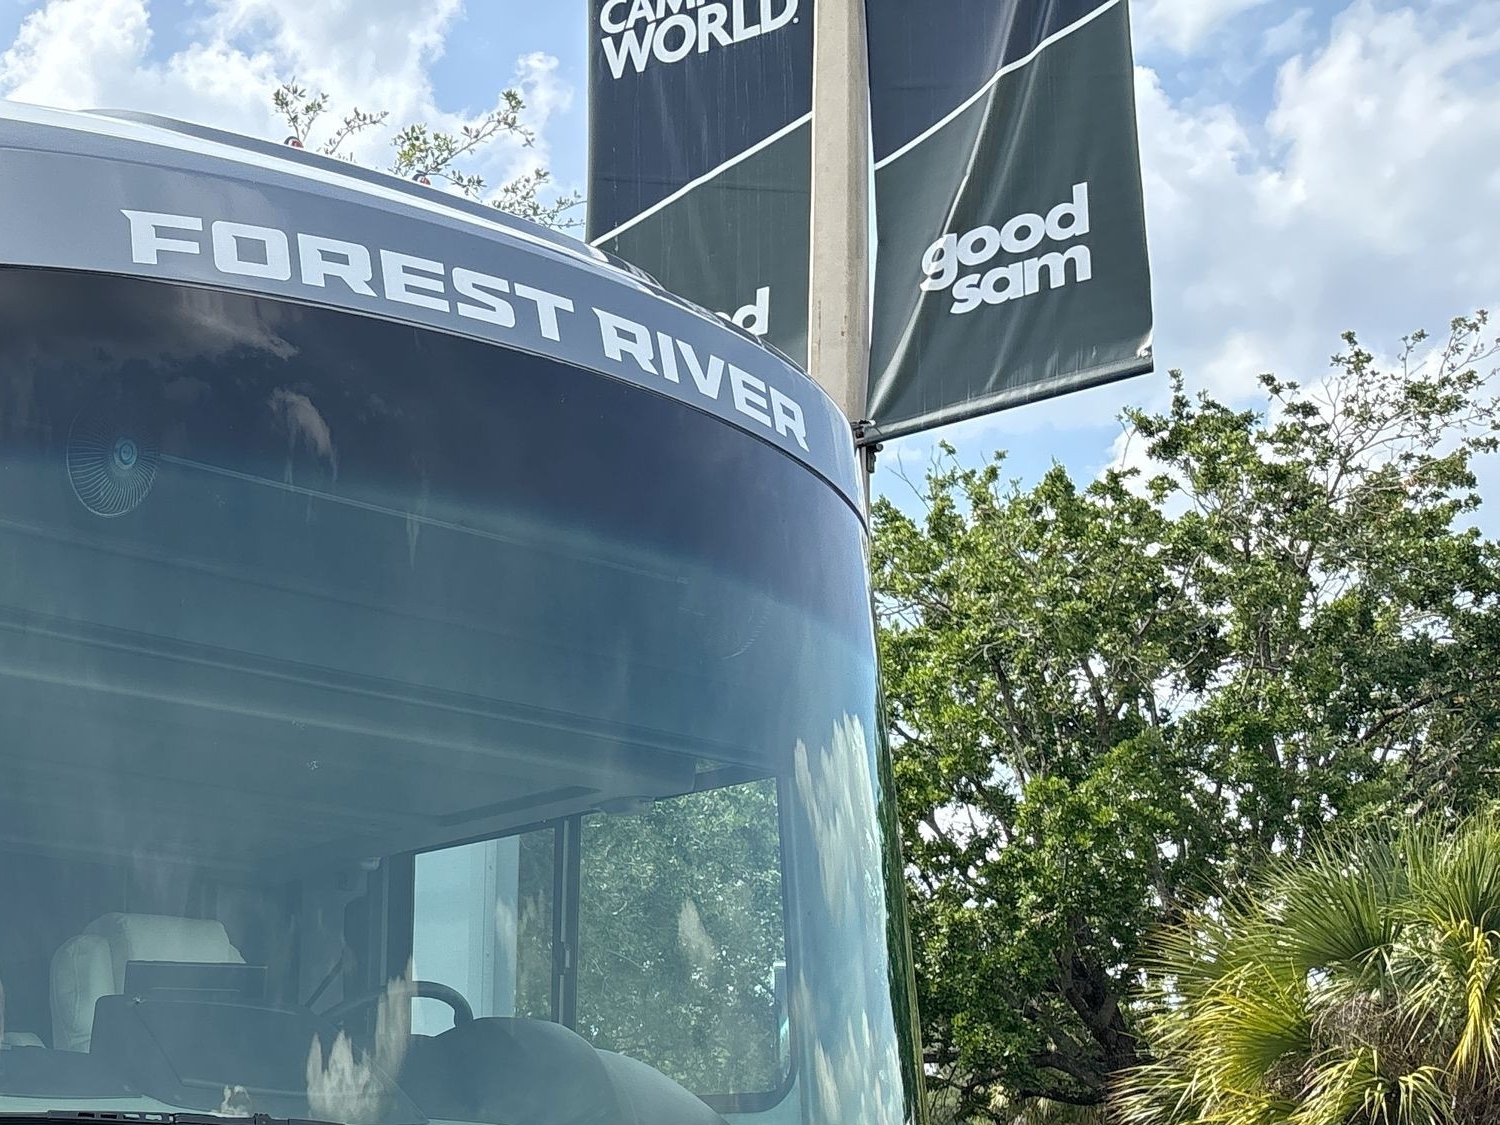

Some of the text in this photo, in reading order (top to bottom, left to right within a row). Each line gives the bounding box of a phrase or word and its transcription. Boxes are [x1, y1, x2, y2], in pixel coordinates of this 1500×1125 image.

[600, 0, 704, 34] CA
[920, 182, 1089, 291] good
[950, 245, 1092, 314] sam
[120, 209, 810, 453] FOREST RIVER
